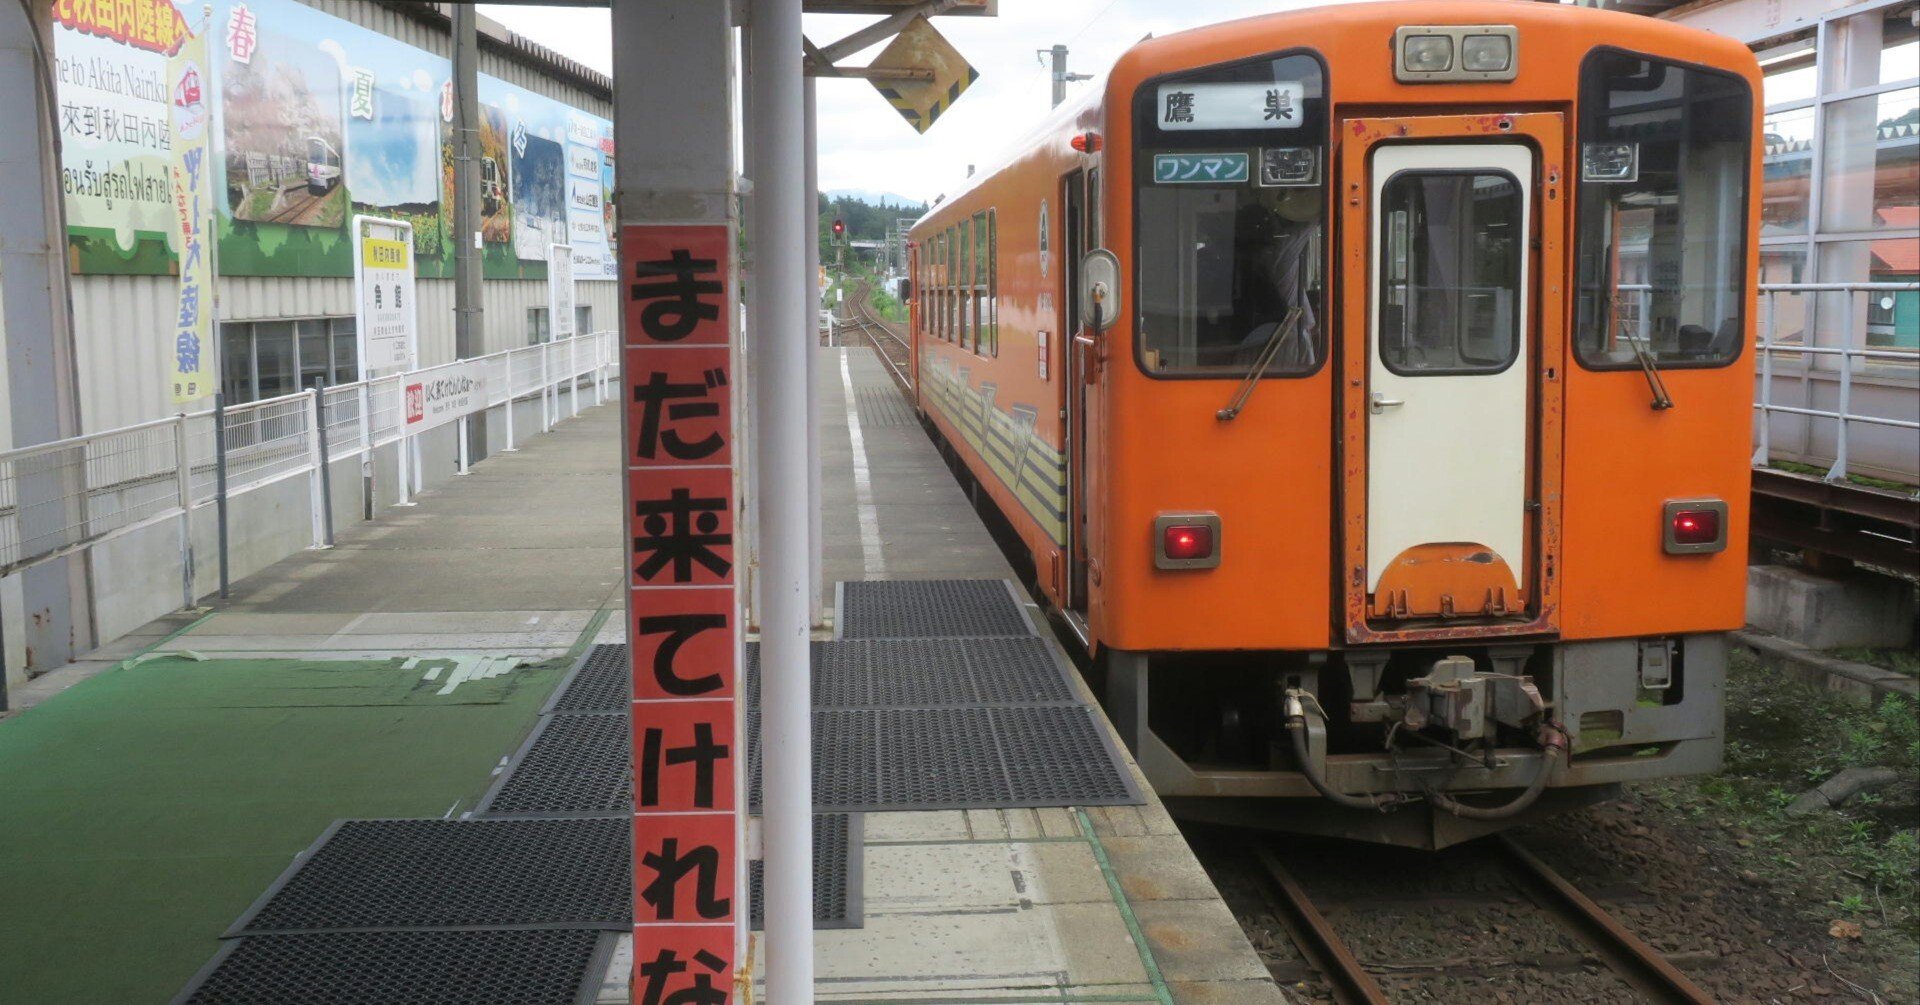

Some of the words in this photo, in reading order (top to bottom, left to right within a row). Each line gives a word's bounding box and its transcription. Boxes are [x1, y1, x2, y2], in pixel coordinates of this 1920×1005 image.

[230, 6, 255, 59] 春
[71, 55, 85, 87] to
[87, 56, 122, 96] Akita
[352, 69, 374, 113] 夏
[1158, 157, 1245, 180] ワンマン
[631, 248, 732, 1005] まだ来てけれな
